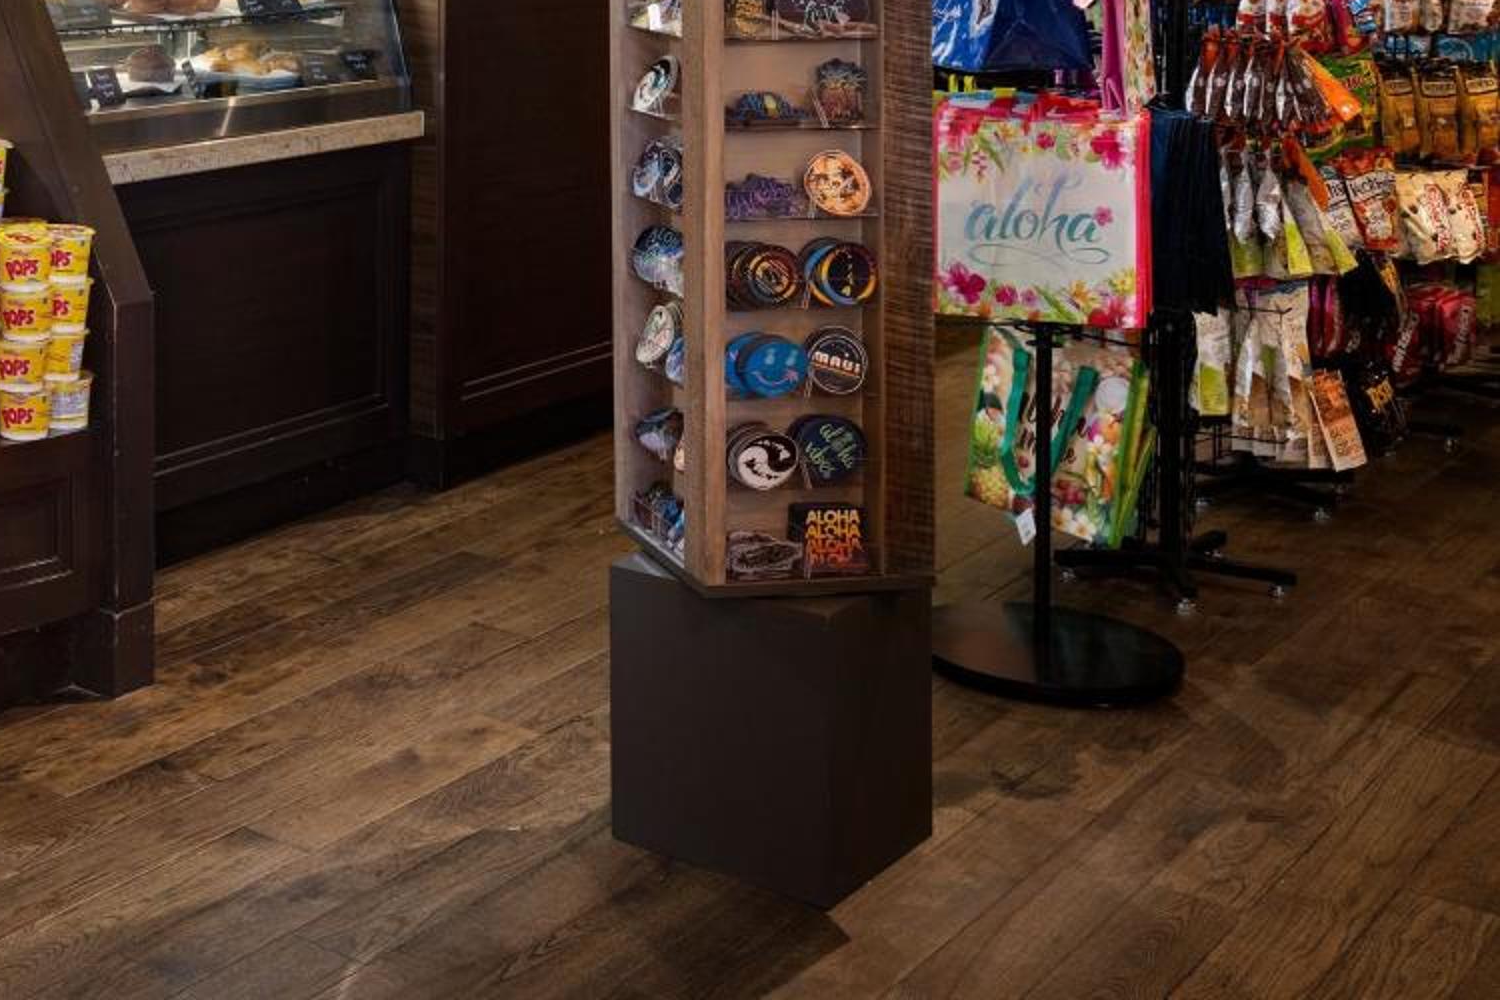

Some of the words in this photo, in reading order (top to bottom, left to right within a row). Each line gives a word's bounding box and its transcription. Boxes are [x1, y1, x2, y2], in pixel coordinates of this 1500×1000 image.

[963, 167, 1106, 258] aloha
[5, 259, 39, 281] POPS
[3, 308, 35, 329] POPS
[1, 408, 34, 427] POPS
[806, 509, 861, 524] ALOHA
[806, 523, 861, 539] ALOHA
